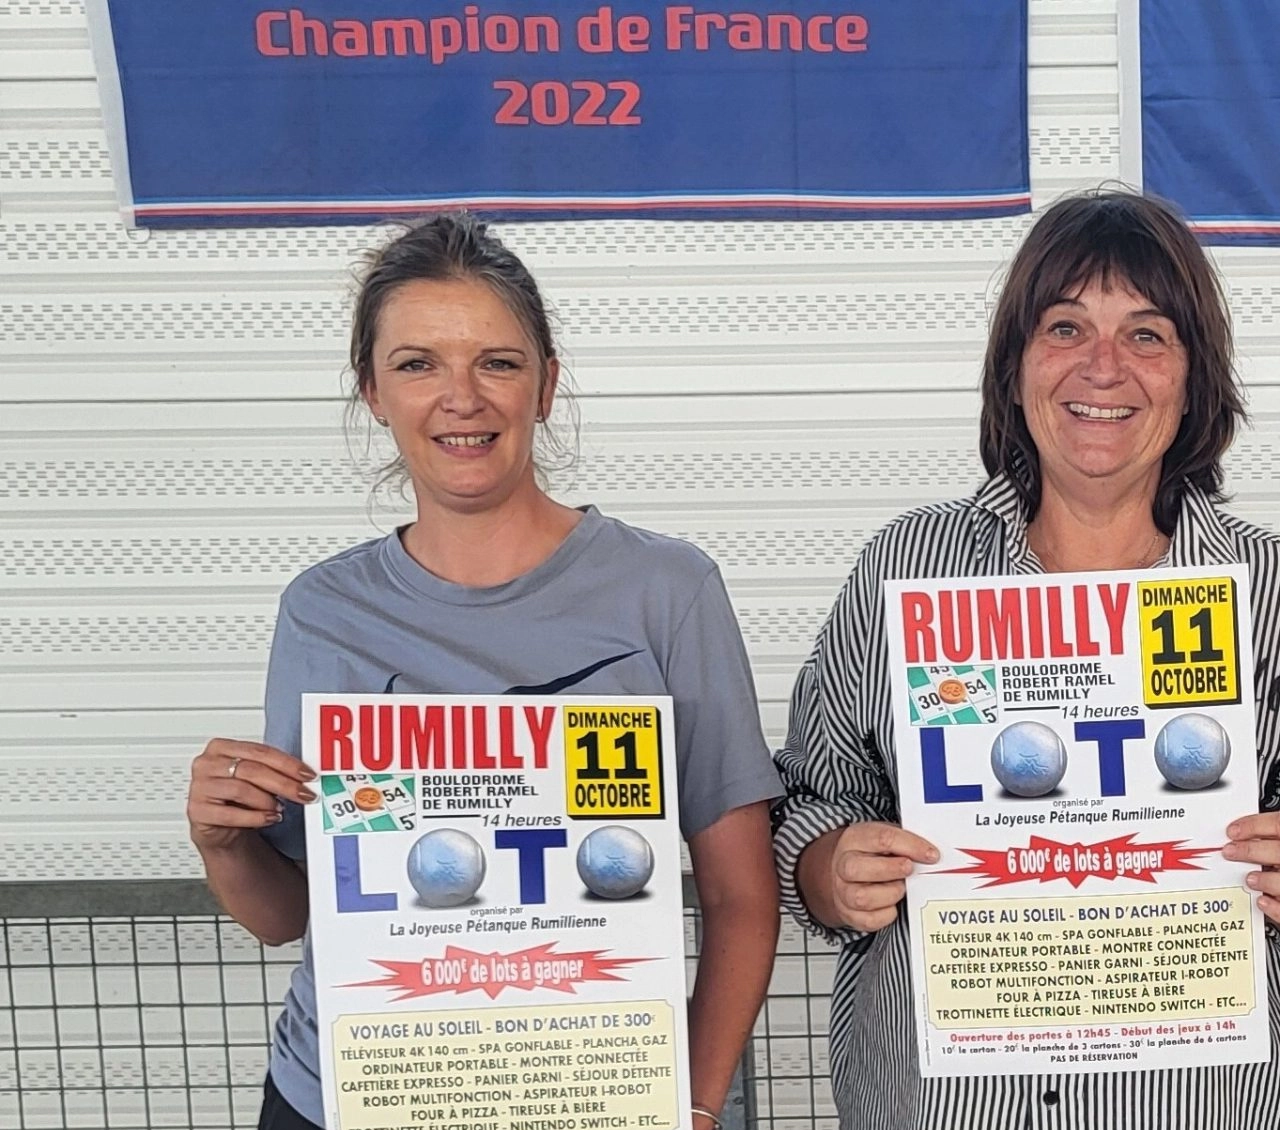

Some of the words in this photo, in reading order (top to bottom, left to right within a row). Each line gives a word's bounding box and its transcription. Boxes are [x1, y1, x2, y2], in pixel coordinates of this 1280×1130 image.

[256, 5, 560, 66] Champion
[577, 7, 650, 54] de
[666, 6, 868, 53] France
[494, 80, 641, 126] 2022
[1142, 584, 1227, 606] DIMANCHE
[901, 583, 1130, 663] RUMILLY
[1152, 607, 1223, 664] 11
[1002, 662, 1101, 676] BOULODROME
[1003, 676, 1058, 689] ROBERT
[1065, 674, 1114, 686] RAMEL
[1151, 666, 1227, 695] OCTOBRE
[1003, 691, 1021, 701] DE
[1027, 688, 1089, 701] RUMILLY
[568, 712, 651, 727] DIMANCHE
[1062, 705, 1078, 718] 14
[1084, 705, 1138, 717] heures
[319, 705, 556, 771] RUMILLY
[576, 731, 647, 779] 11
[422, 775, 524, 785] BOULODROME
[422, 786, 480, 797] ROBERT
[487, 786, 537, 795] RAMEL
[575, 783, 650, 807] OCTOBRE
[423, 799, 440, 809] DE
[447, 798, 511, 808] RUMILLY
[482, 814, 499, 826] 14
[505, 814, 561, 826] heures
[976, 814, 989, 825] La
[994, 813, 1045, 827] Joyeuse
[1050, 811, 1107, 824] Pétanque
[1112, 807, 1184, 820] Rumillienne
[1007, 853, 1017, 873] 6
[1053, 851, 1071, 872] de
[1073, 850, 1100, 871] lots
[1103, 849, 1112, 870] à
[1115, 848, 1163, 874] gagner
[390, 923, 404, 935] La
[409, 922, 462, 937] Joyeuse
[466, 919, 527, 933] Pétanque
[531, 915, 606, 929] Rumillienne
